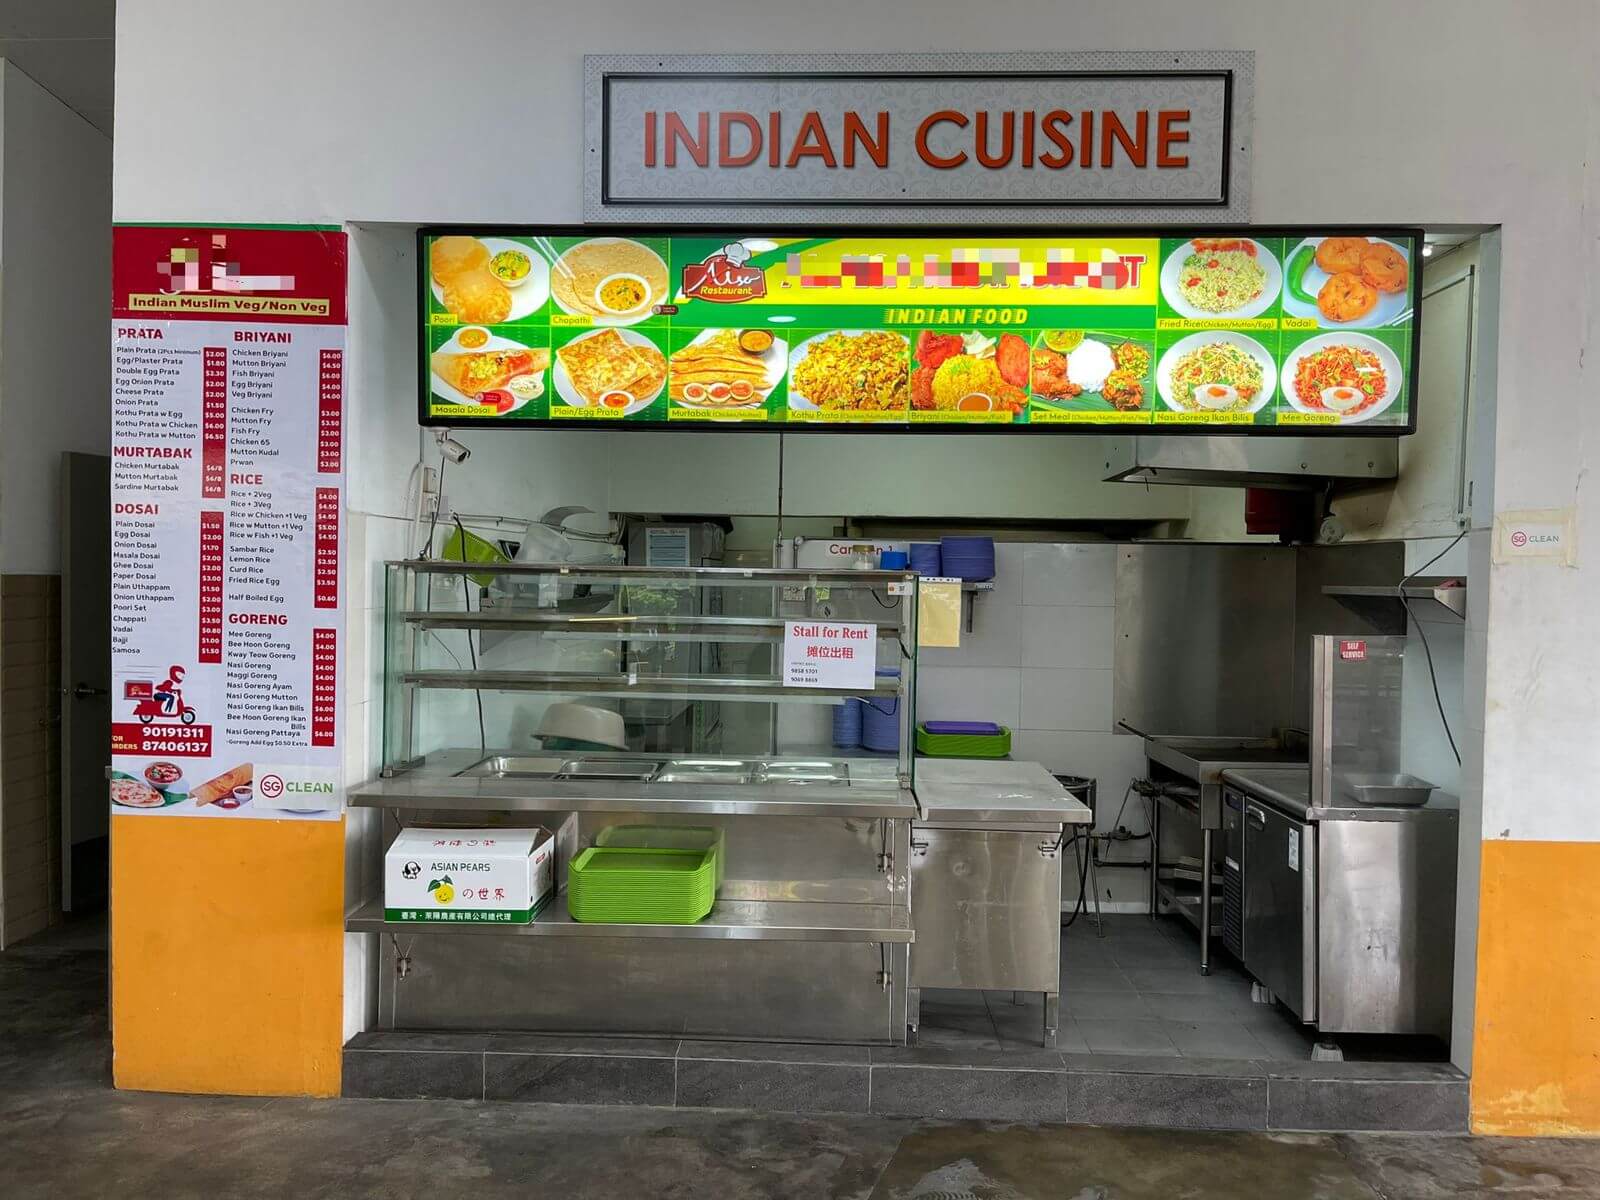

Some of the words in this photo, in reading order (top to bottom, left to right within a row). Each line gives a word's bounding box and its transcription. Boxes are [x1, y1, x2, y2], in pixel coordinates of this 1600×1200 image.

[644, 110, 888, 169] INDIAN
[915, 109, 1189, 169] CUISINE
[701, 286, 752, 294] Restaurant
[134, 298, 177, 307] Indian
[180, 299, 229, 308] Muslim
[235, 300, 296, 311] Veg/Non
[301, 302, 327, 314] Veg
[553, 316, 590, 325] Chapathi
[883, 308, 965, 324] INDIAN
[972, 308, 1029, 324] FOOD
[1160, 320, 1181, 328] Fried
[118, 328, 163, 339] PRATA
[234, 332, 291, 343] BRIYANI
[232, 391, 245, 399] Veg
[262, 408, 273, 416] Fry
[435, 406, 465, 414] Masala
[468, 406, 490, 414] Dosai
[554, 408, 594, 418] Plain/Egg
[597, 408, 619, 416] Prata
[792, 411, 815, 419] Kothu
[912, 412, 940, 421] Briyani
[1033, 412, 1046, 420] Set
[1049, 412, 1070, 420] Meal
[1179, 414, 1210, 424] Goreng
[1303, 414, 1335, 424] Goreng
[248, 428, 260, 436] Fry
[114, 447, 192, 458] MURTABAK
[231, 474, 262, 484] RICE
[115, 504, 158, 514] DOSAI
[1529, 535, 1559, 543] CLEAN
[136, 594, 174, 602] Uthappam
[113, 615, 146, 623] Chappati
[229, 614, 288, 625] GORENG
[245, 631, 271, 639] Goreng
[793, 625, 818, 637] Stall
[823, 627, 839, 638] for
[843, 628, 868, 639] Rent
[264, 642, 290, 650] Goreng
[269, 652, 295, 660] Goreng
[807, 646, 853, 659] 摊位出租
[245, 662, 271, 670] Goreng
[244, 683, 270, 691] Goreng
[143, 727, 203, 738] 90191311
[143, 741, 208, 752] 87406137
[286, 782, 333, 793] CLEAN
[431, 863, 458, 871] ASIAN
[461, 863, 490, 872] PEARS
